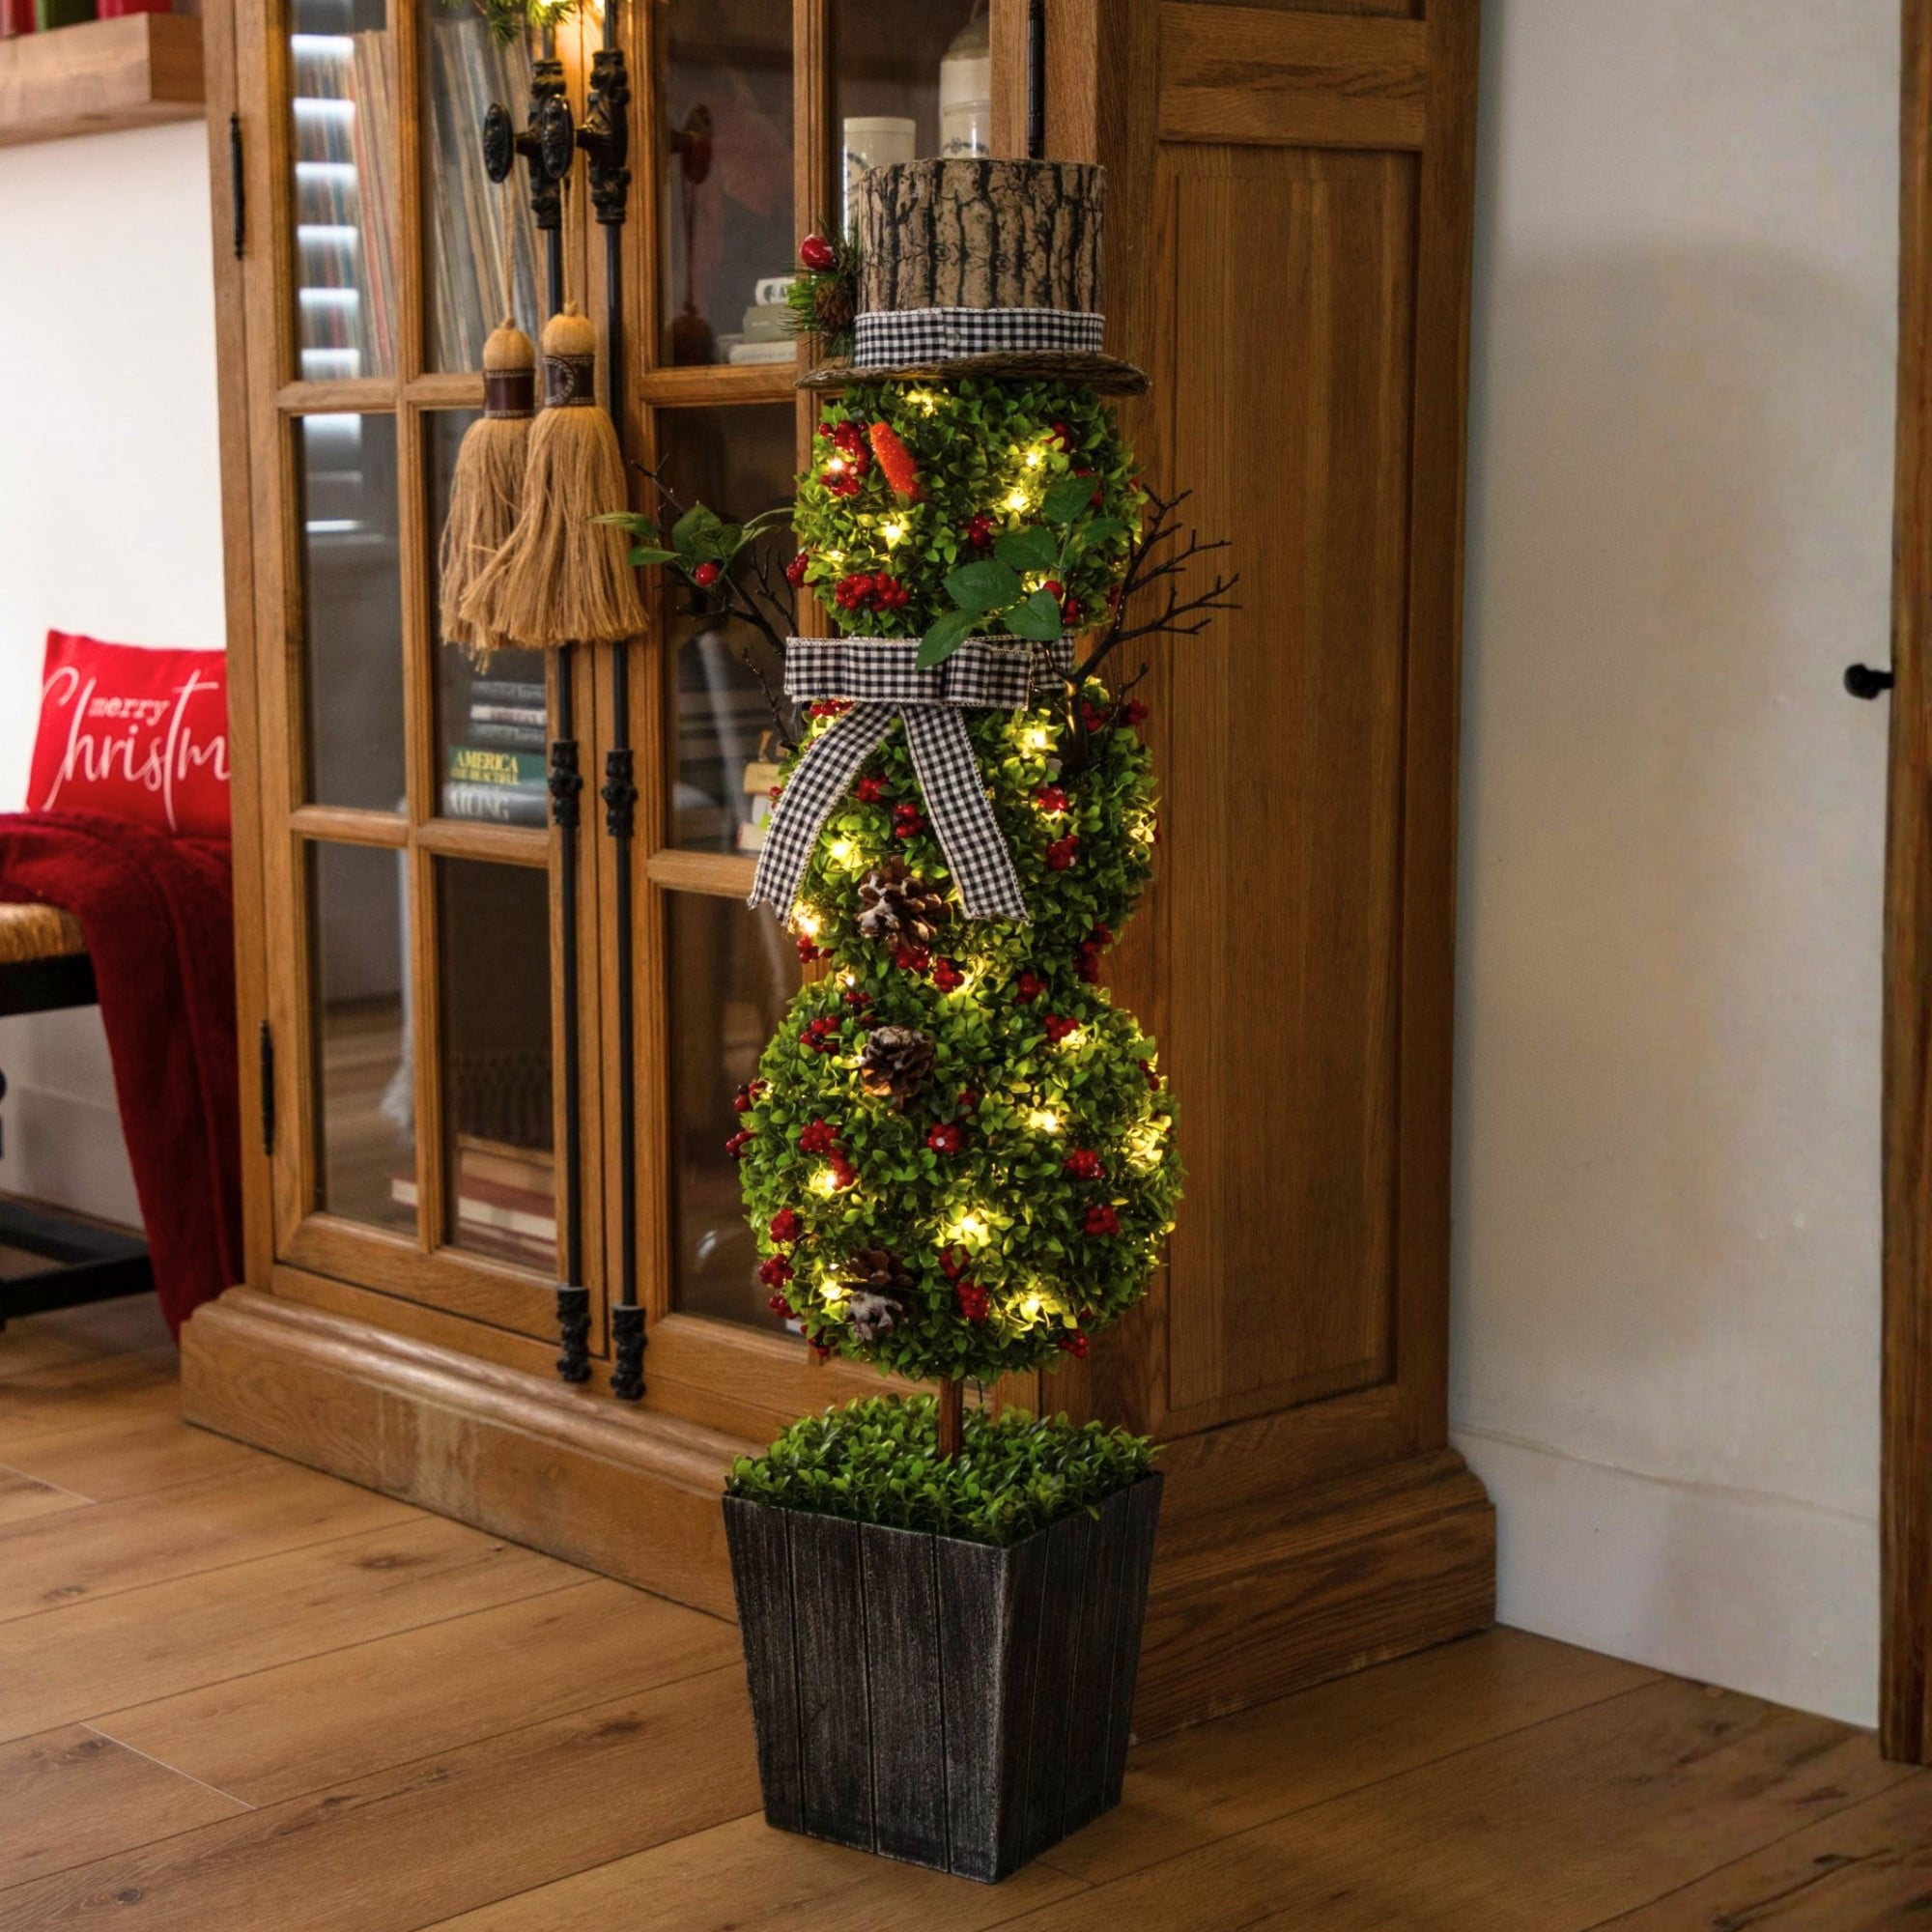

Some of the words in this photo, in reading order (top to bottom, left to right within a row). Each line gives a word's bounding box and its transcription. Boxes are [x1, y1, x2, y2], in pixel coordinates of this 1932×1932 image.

[88, 696, 170, 726] merry
[26, 666, 231, 832] Christm
[454, 750, 519, 774] AMERICA
